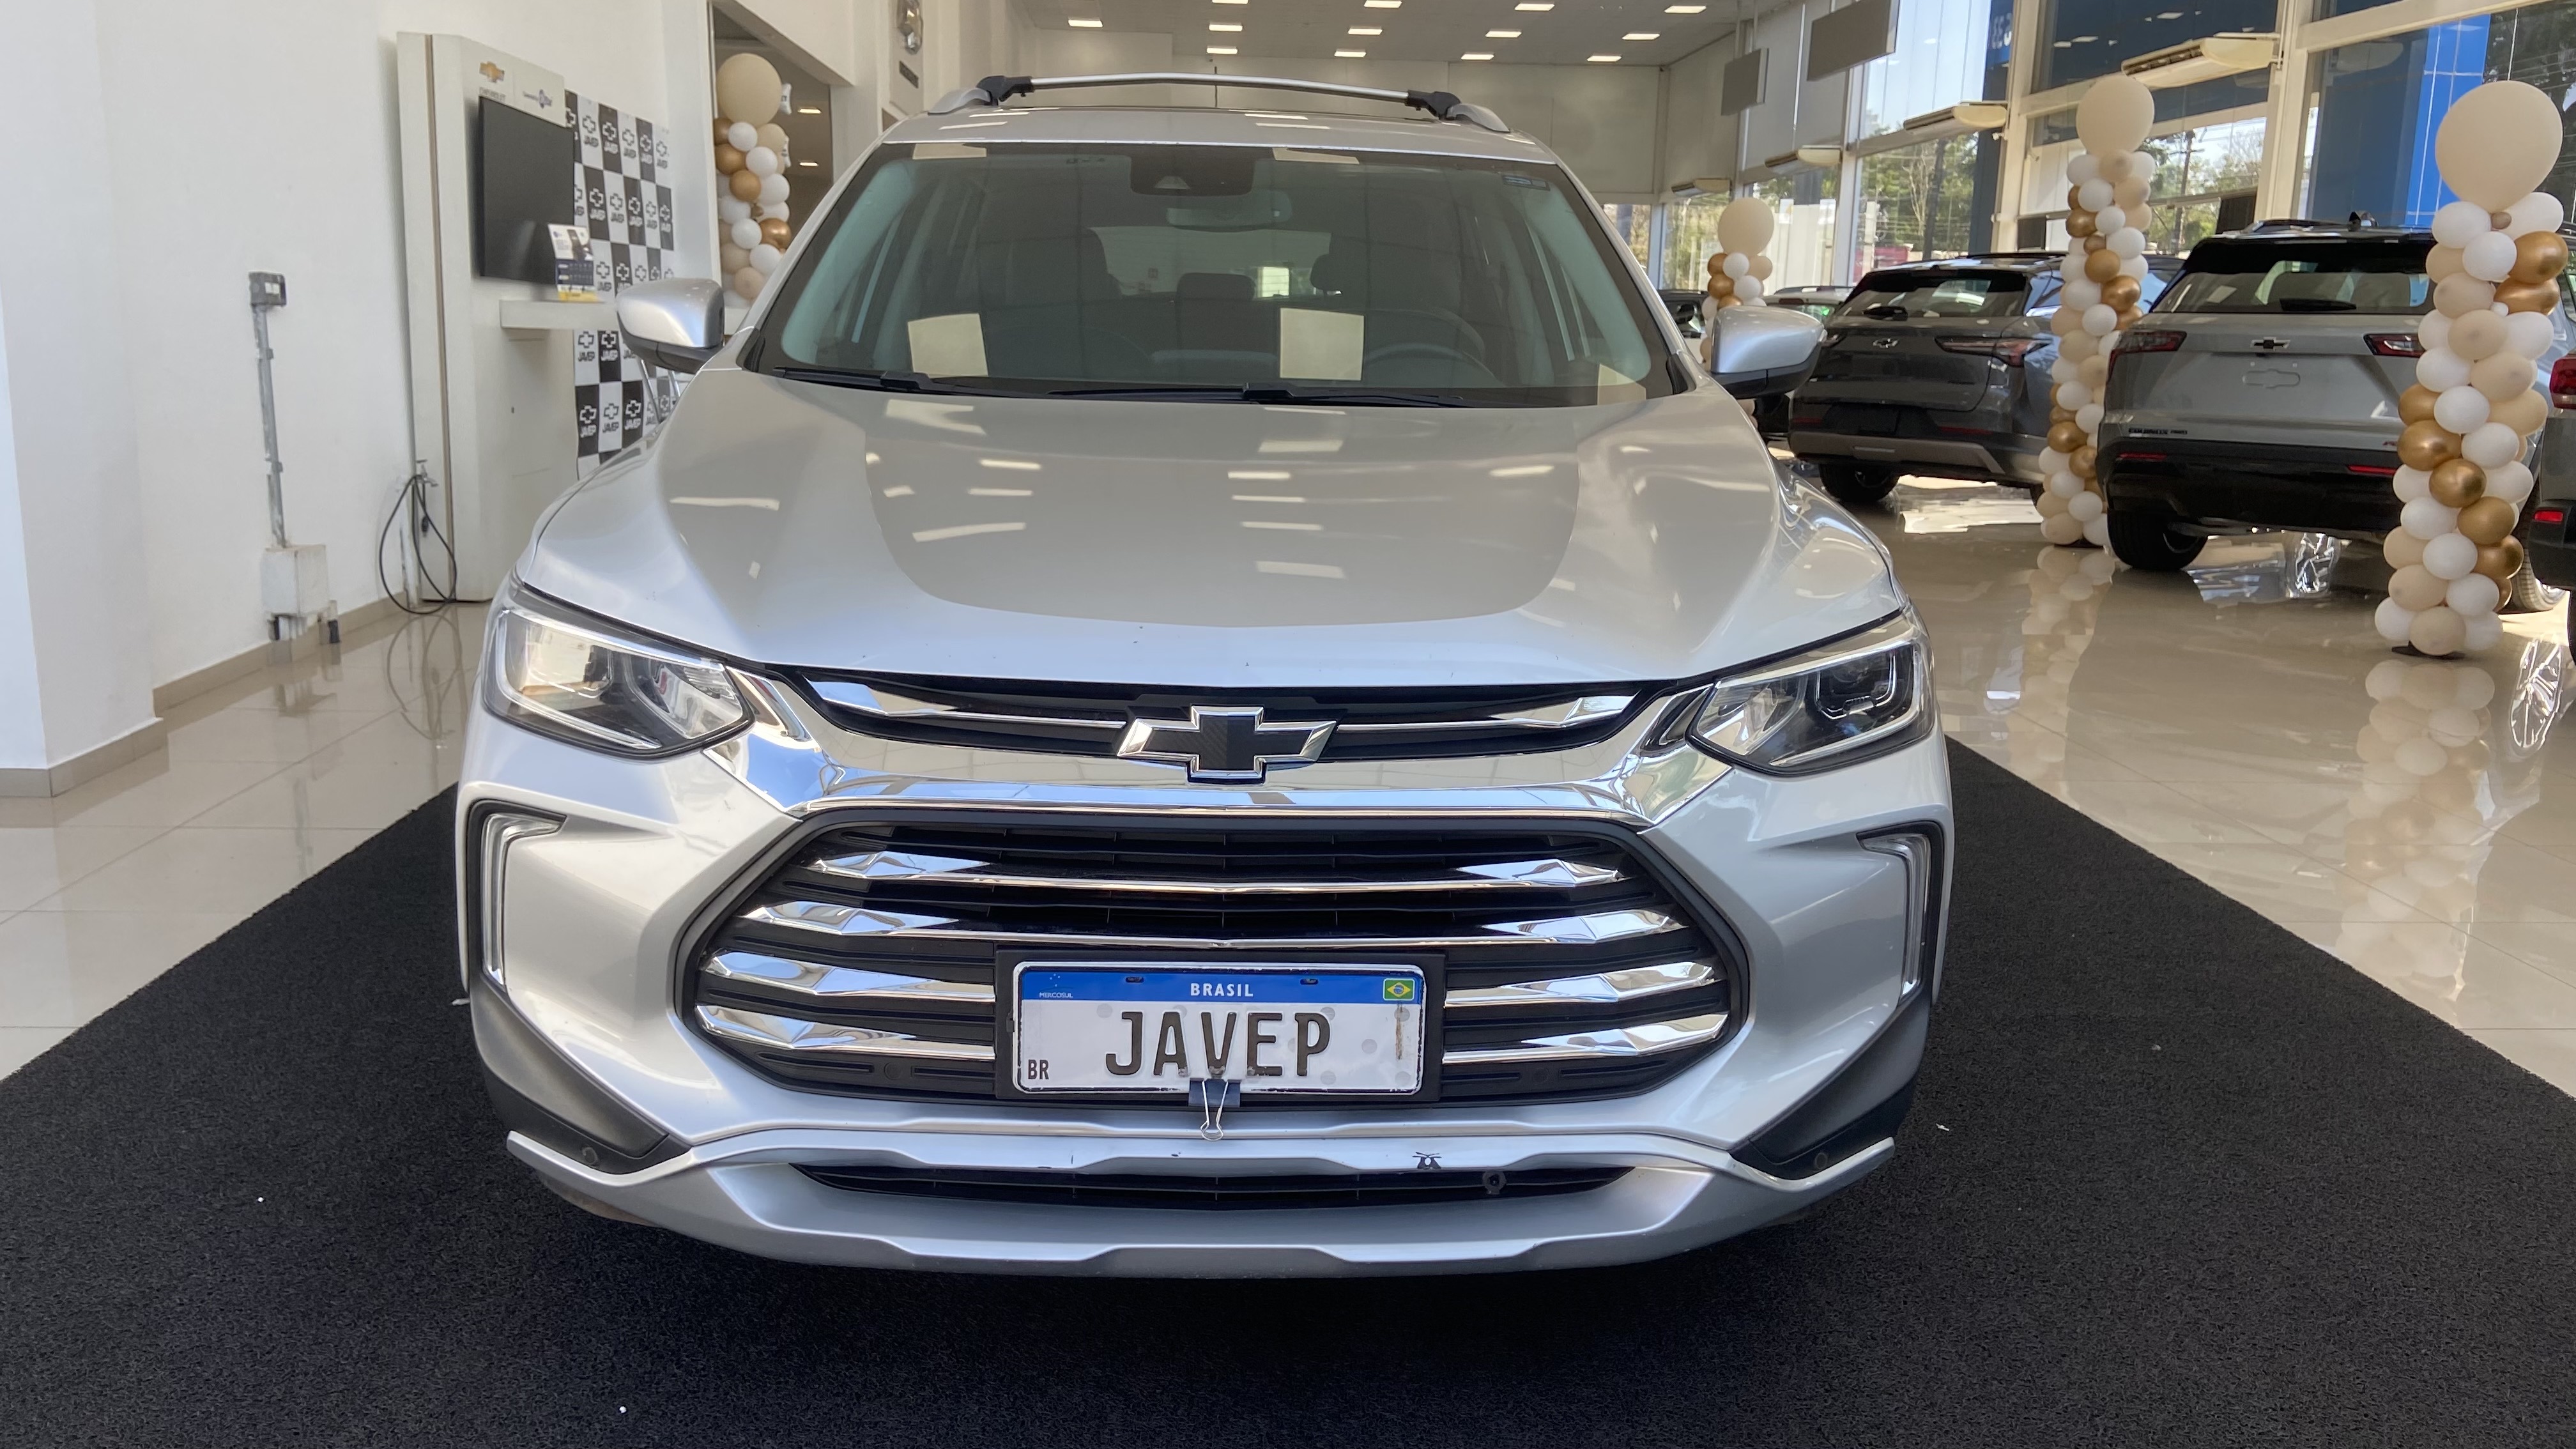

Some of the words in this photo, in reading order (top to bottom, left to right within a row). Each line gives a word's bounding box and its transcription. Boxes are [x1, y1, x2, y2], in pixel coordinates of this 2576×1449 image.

[1190, 983, 1254, 997] BRASIL
[1105, 1011, 1331, 1077] JAVEP
[1028, 1059, 1049, 1080] BR
